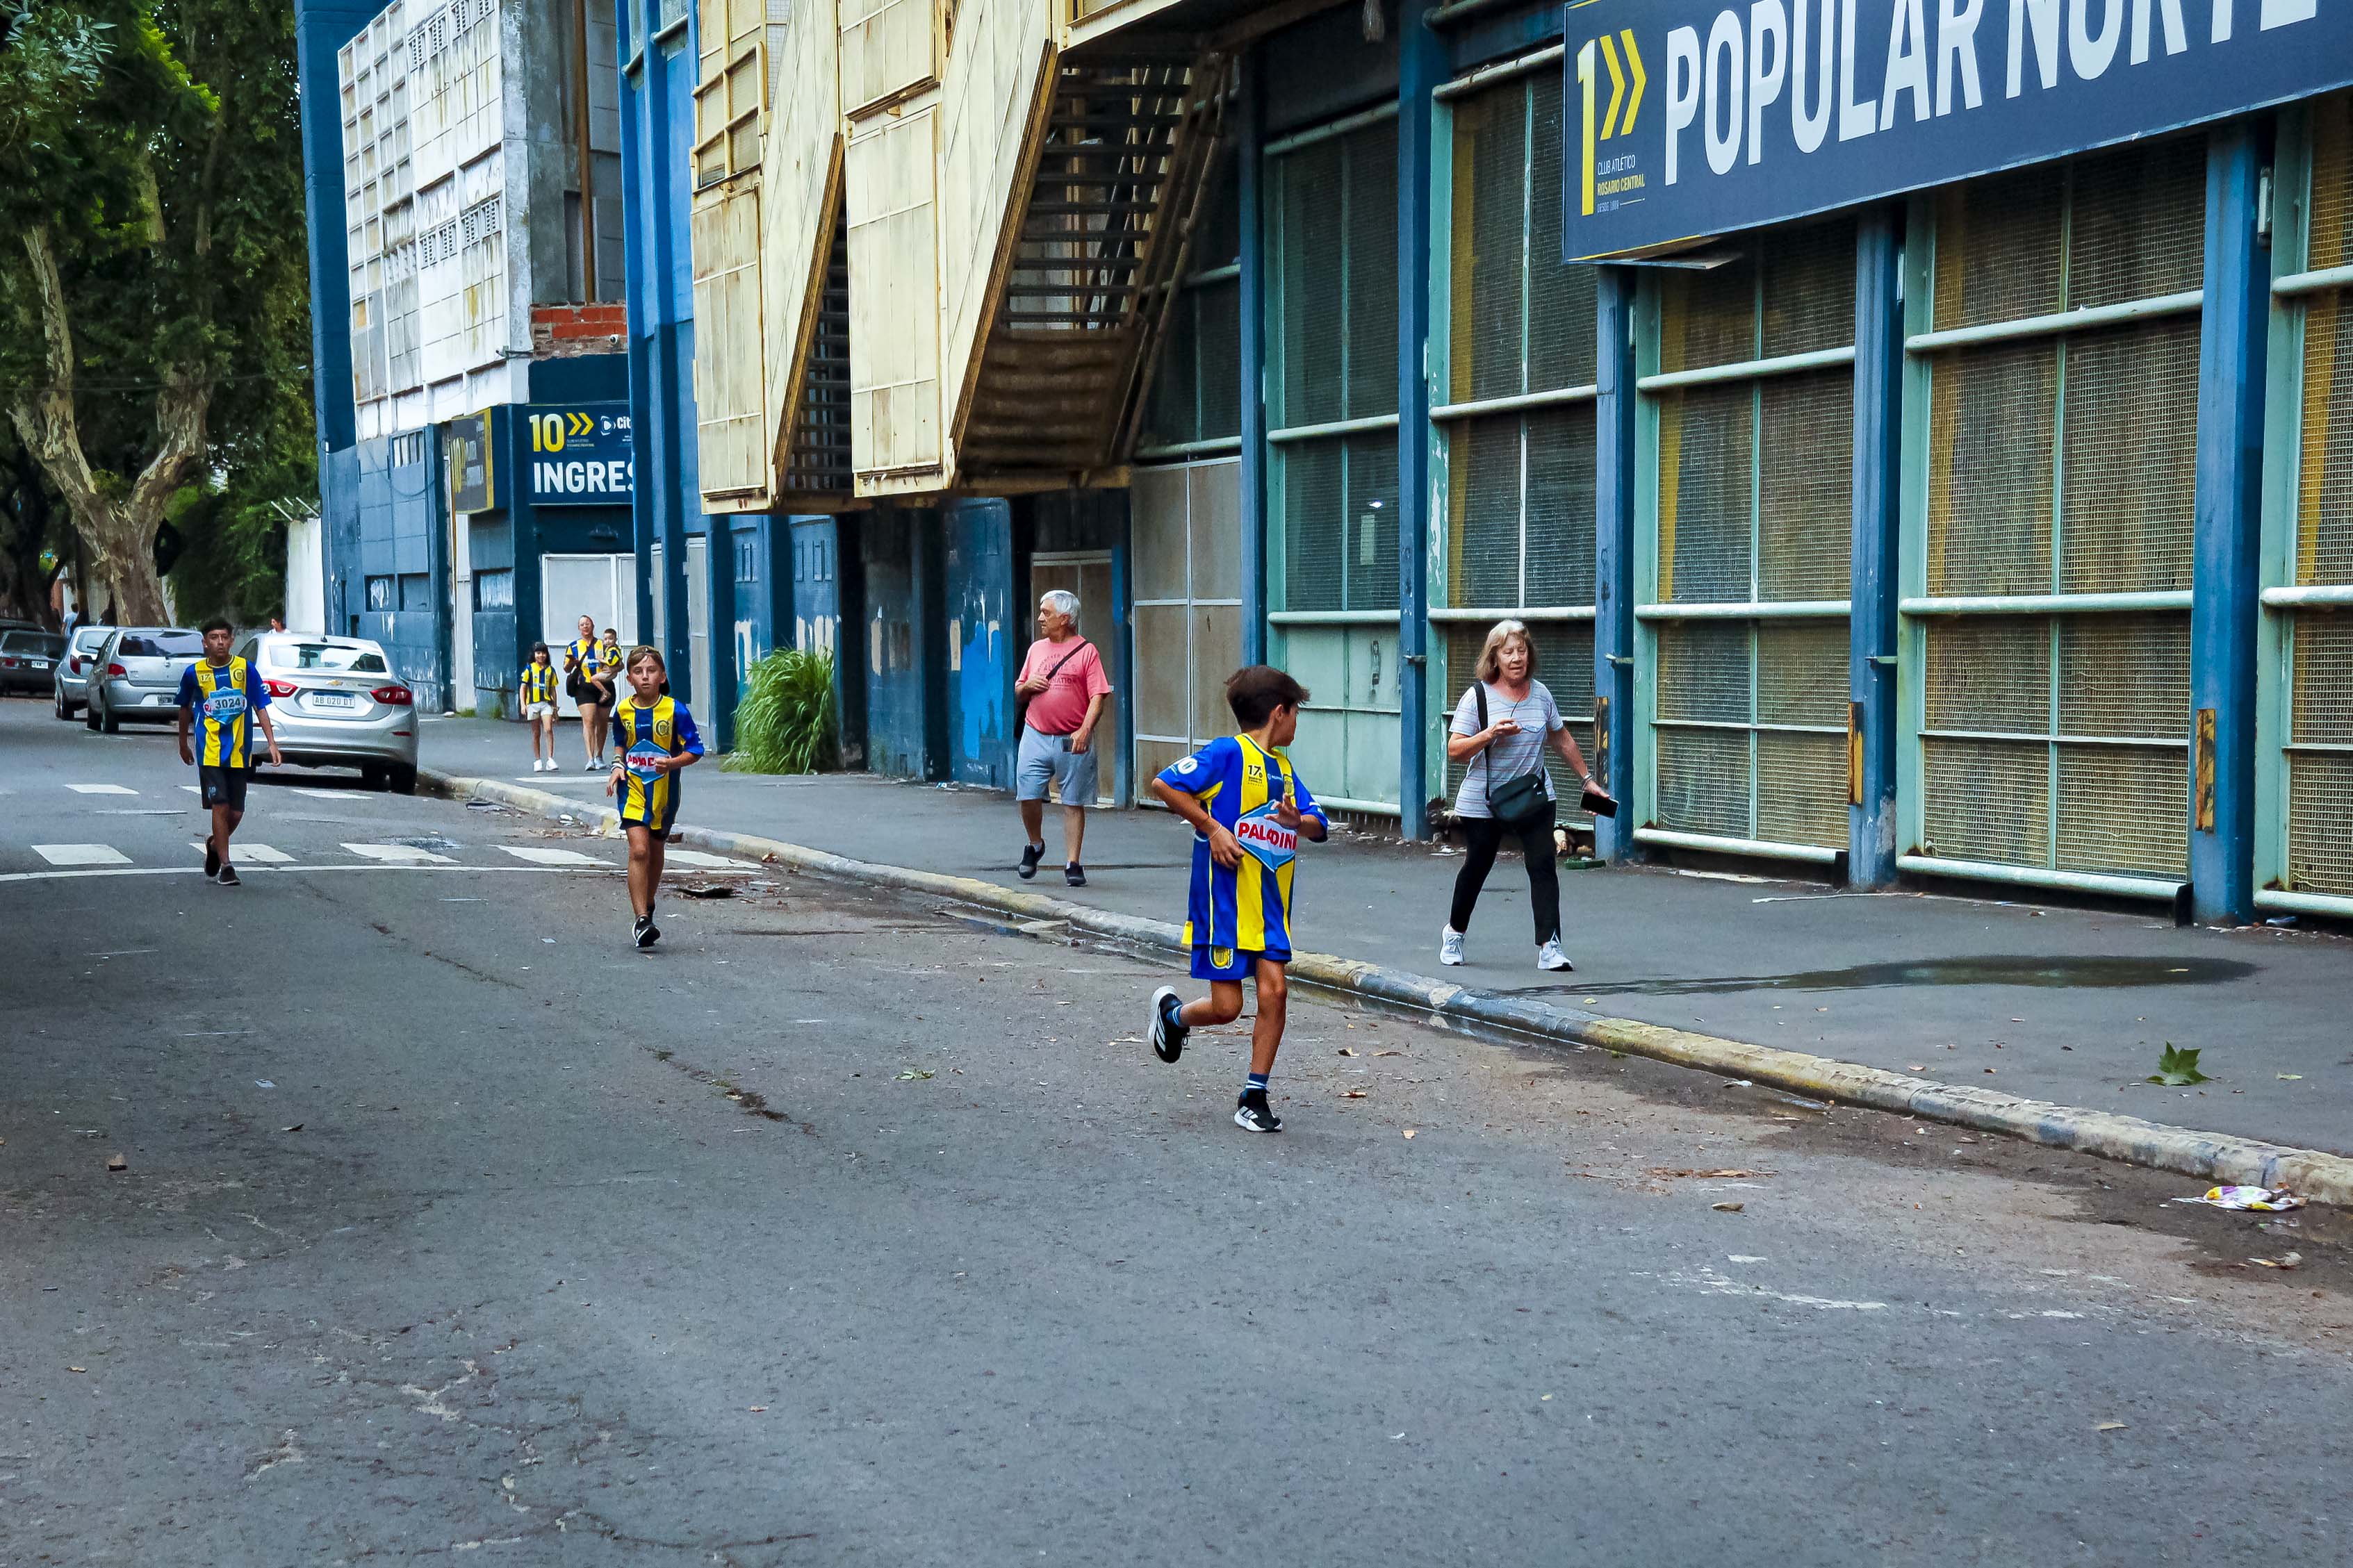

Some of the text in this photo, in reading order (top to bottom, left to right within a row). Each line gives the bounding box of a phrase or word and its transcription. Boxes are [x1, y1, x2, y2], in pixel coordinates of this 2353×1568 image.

[1664, 0, 1983, 186] POPULAR
[1577, 39, 1596, 216] 1
[1598, 153, 1636, 176] CLUB ATLÉTICO
[1597, 173, 1646, 197] ROSARIO CENTRAL
[528, 413, 565, 452] 10
[215, 697, 241, 709] 3024
[315, 695, 325, 704] AB
